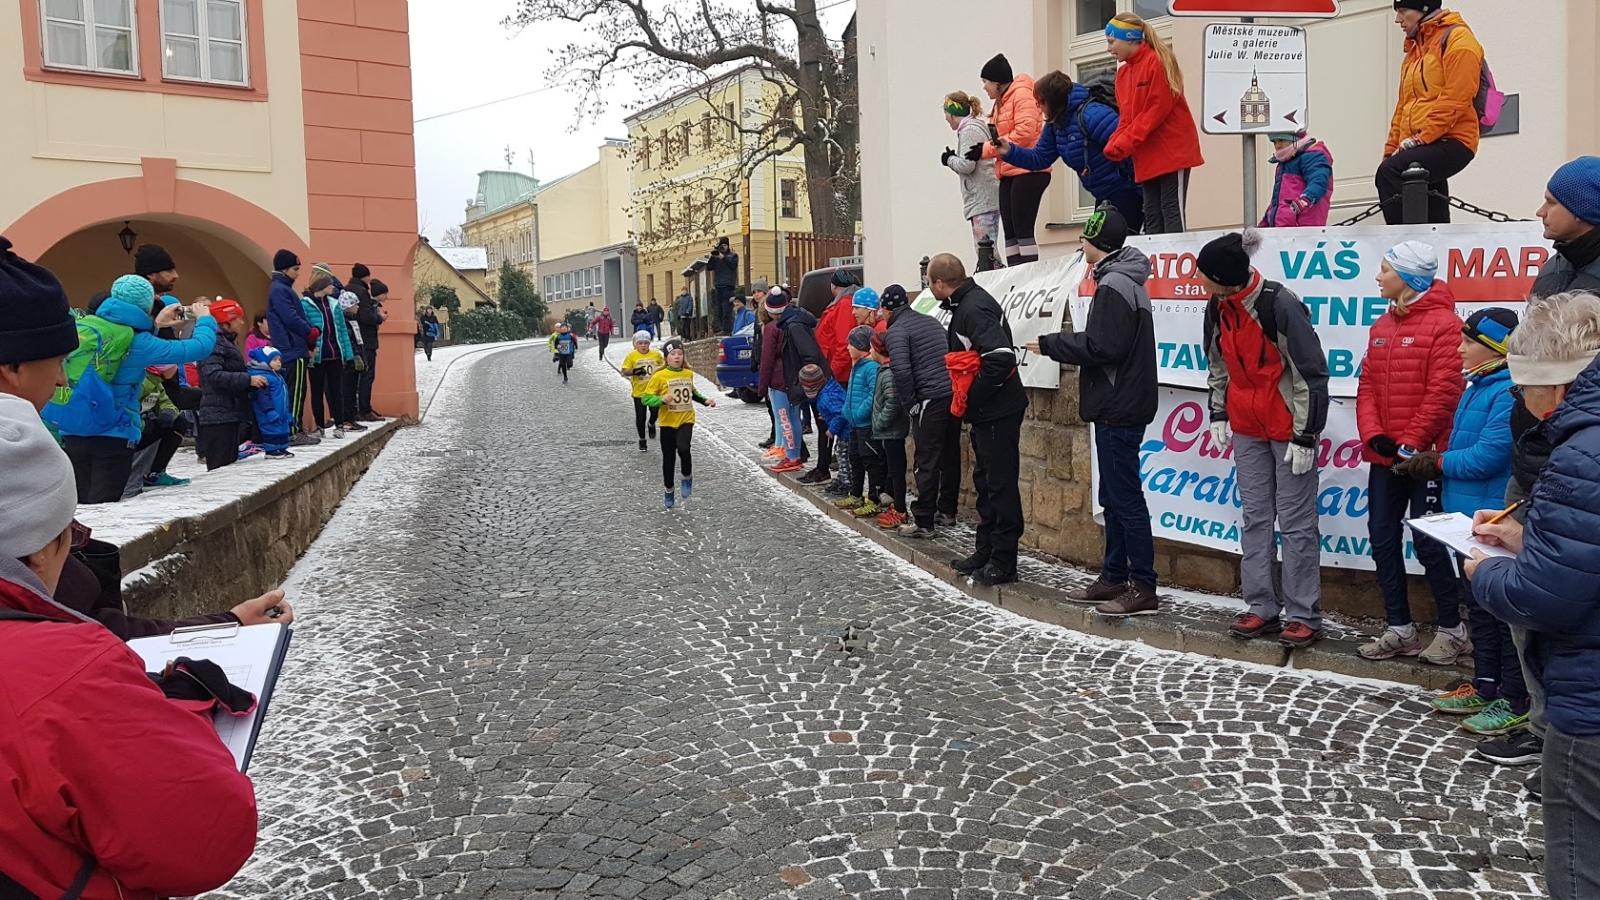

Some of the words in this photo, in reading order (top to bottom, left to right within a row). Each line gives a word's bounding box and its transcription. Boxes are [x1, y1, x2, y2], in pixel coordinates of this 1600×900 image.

[1212, 26, 1254, 36] Městské
[1257, 28, 1299, 37] muzeum
[1232, 39, 1238, 47] a
[1242, 38, 1278, 49] galerie
[1207, 50, 1232, 59] Julie
[1237, 50, 1249, 60] W.
[1254, 50, 1303, 60] Mezerové
[1280, 241, 1361, 281] VÁŠ
[1448, 247, 1549, 279] MAR
[1303, 297, 1390, 326] TNE
[1158, 342, 1210, 370] TAV
[673, 387, 690, 404] 39
[778, 407, 795, 450] adidas
[1160, 511, 1244, 543] CUKRÁ
[1319, 534, 1374, 556] KAV
